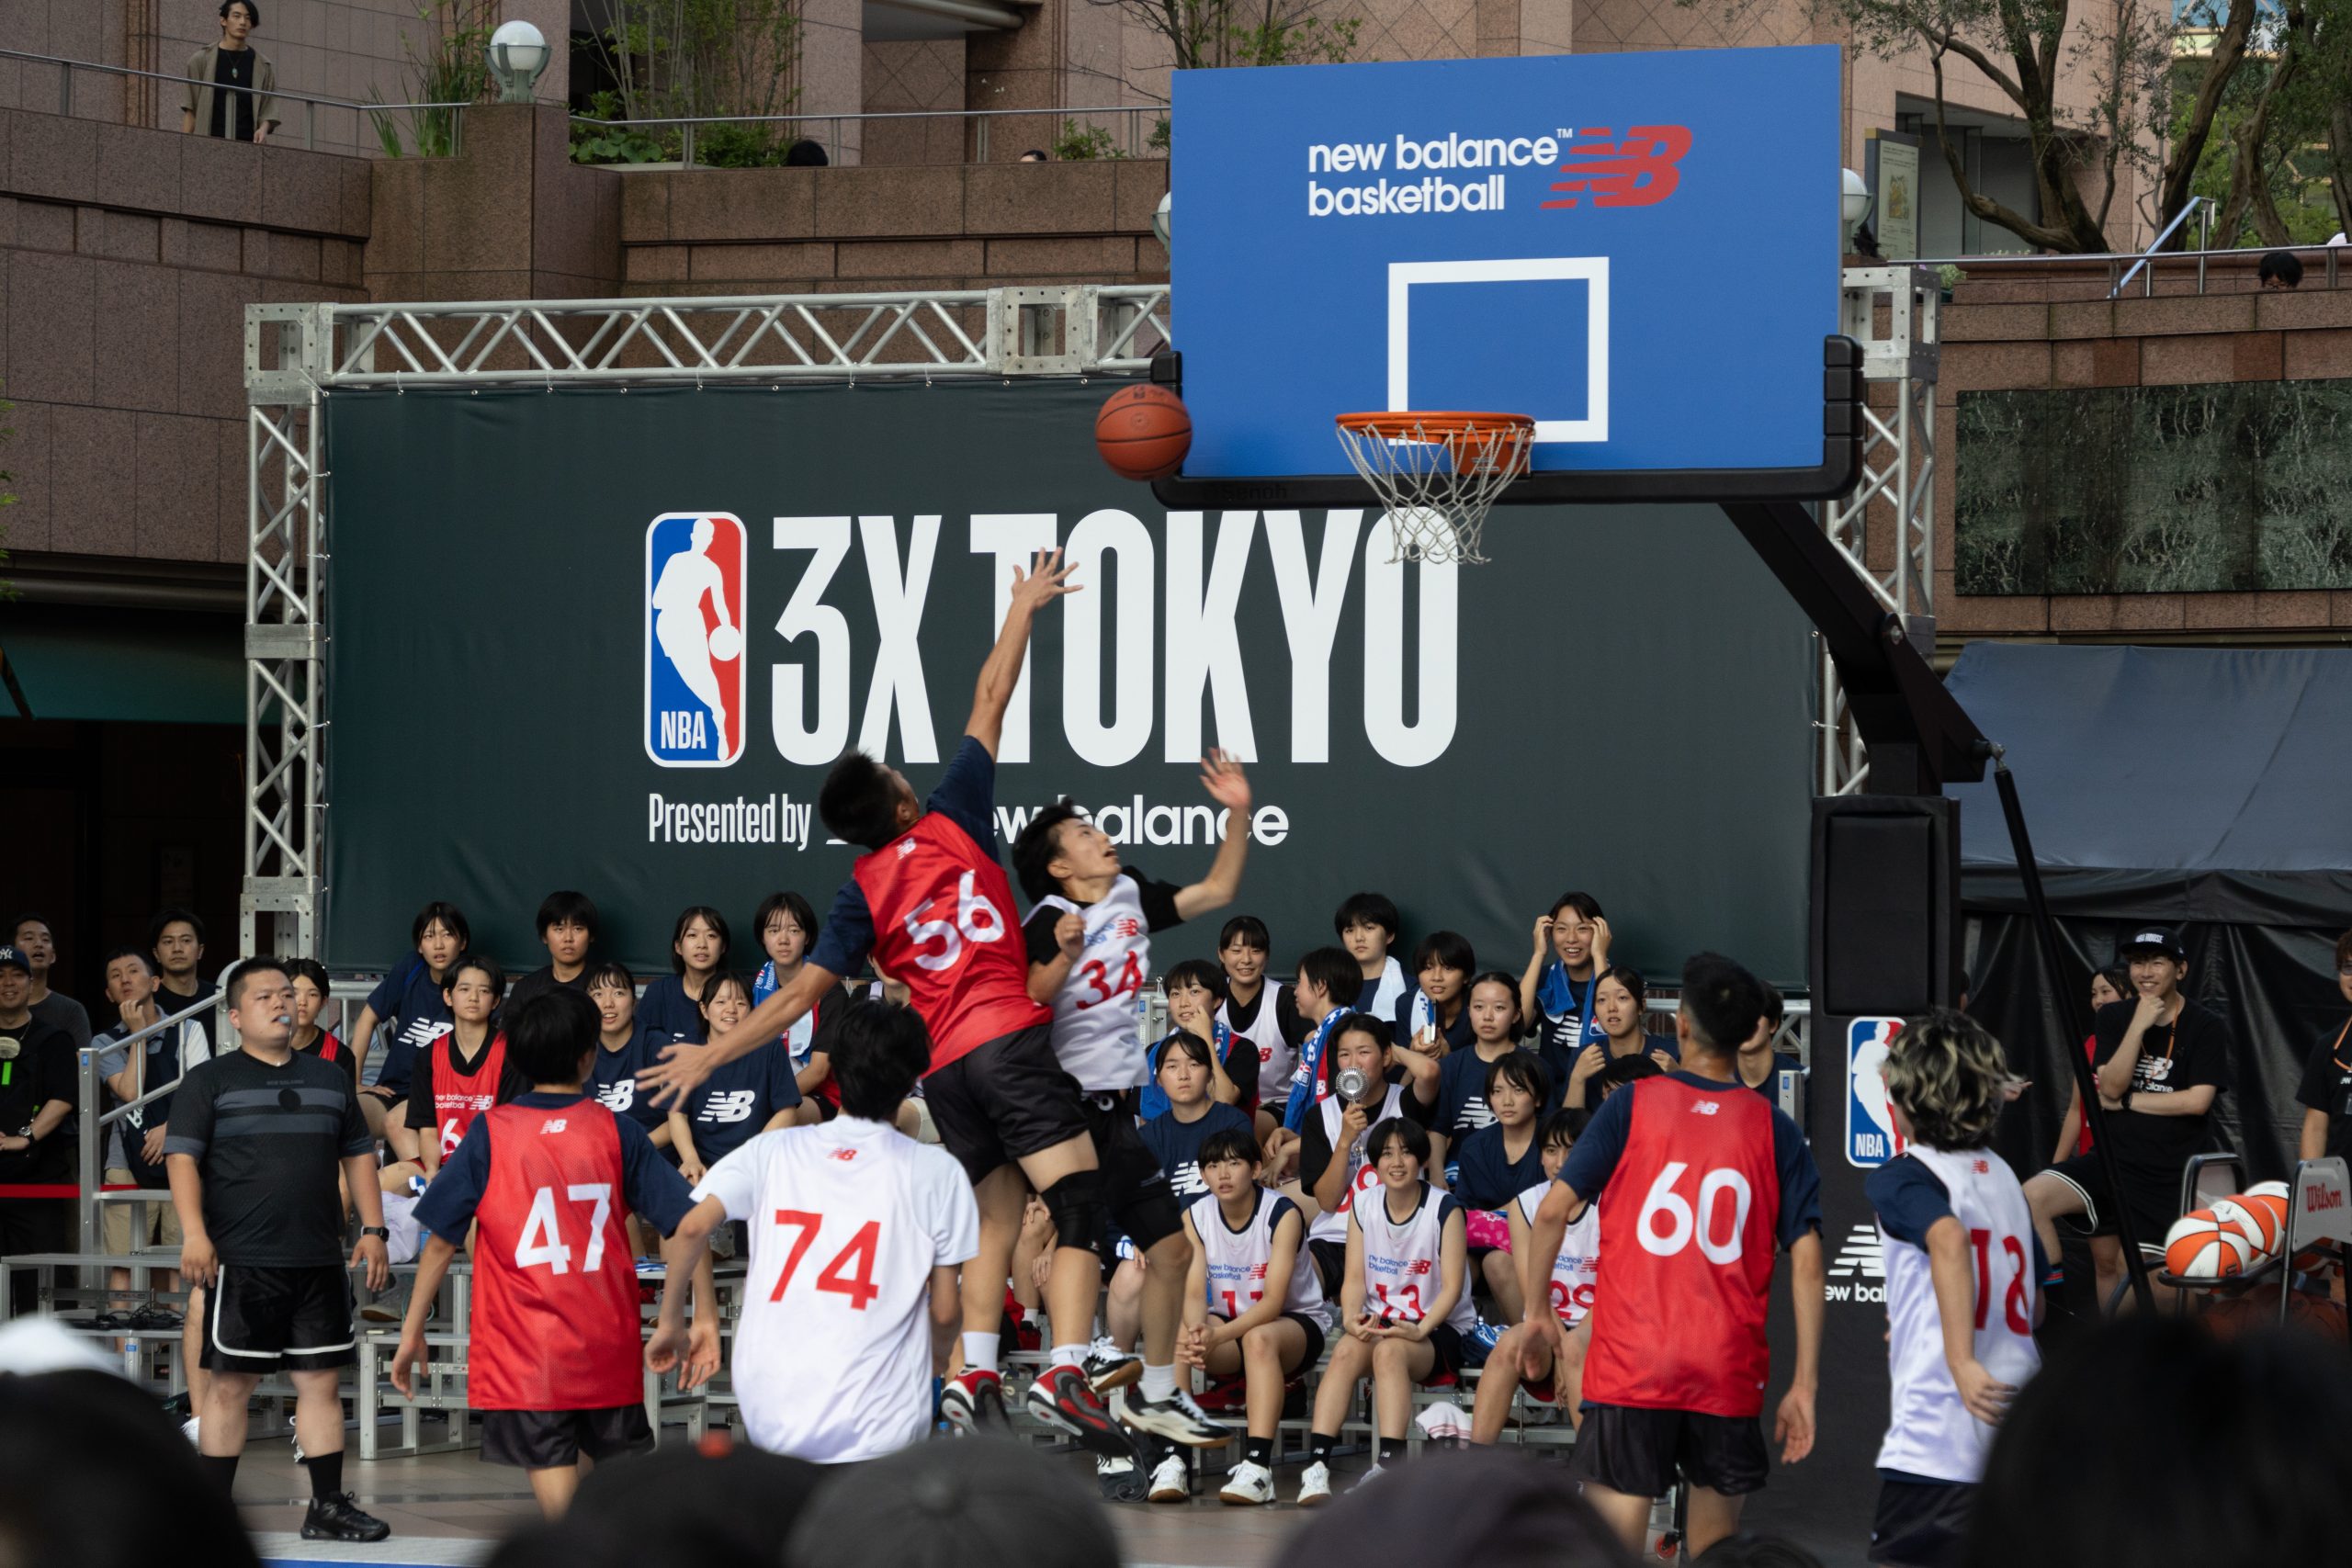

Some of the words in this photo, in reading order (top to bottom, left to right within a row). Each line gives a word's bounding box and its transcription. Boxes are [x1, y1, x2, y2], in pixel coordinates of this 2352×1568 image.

[1308, 143, 1387, 173] new
[1308, 175, 1505, 216] basketball
[772, 513, 942, 766] 3X
[969, 507, 1459, 768] TOKYO
[660, 711, 707, 750] NBA
[649, 793, 776, 843] Presented
[782, 793, 812, 852] by
[904, 868, 1005, 972] 56
[1075, 949, 1144, 1010] 34
[1855, 1133, 1884, 1157] NBA
[1636, 1160, 1752, 1266] 60
[2306, 1183, 2343, 1213] Wilson
[514, 1182, 612, 1276] 47
[769, 1209, 881, 1311] 74
[1375, 1282, 1426, 1320] 13
